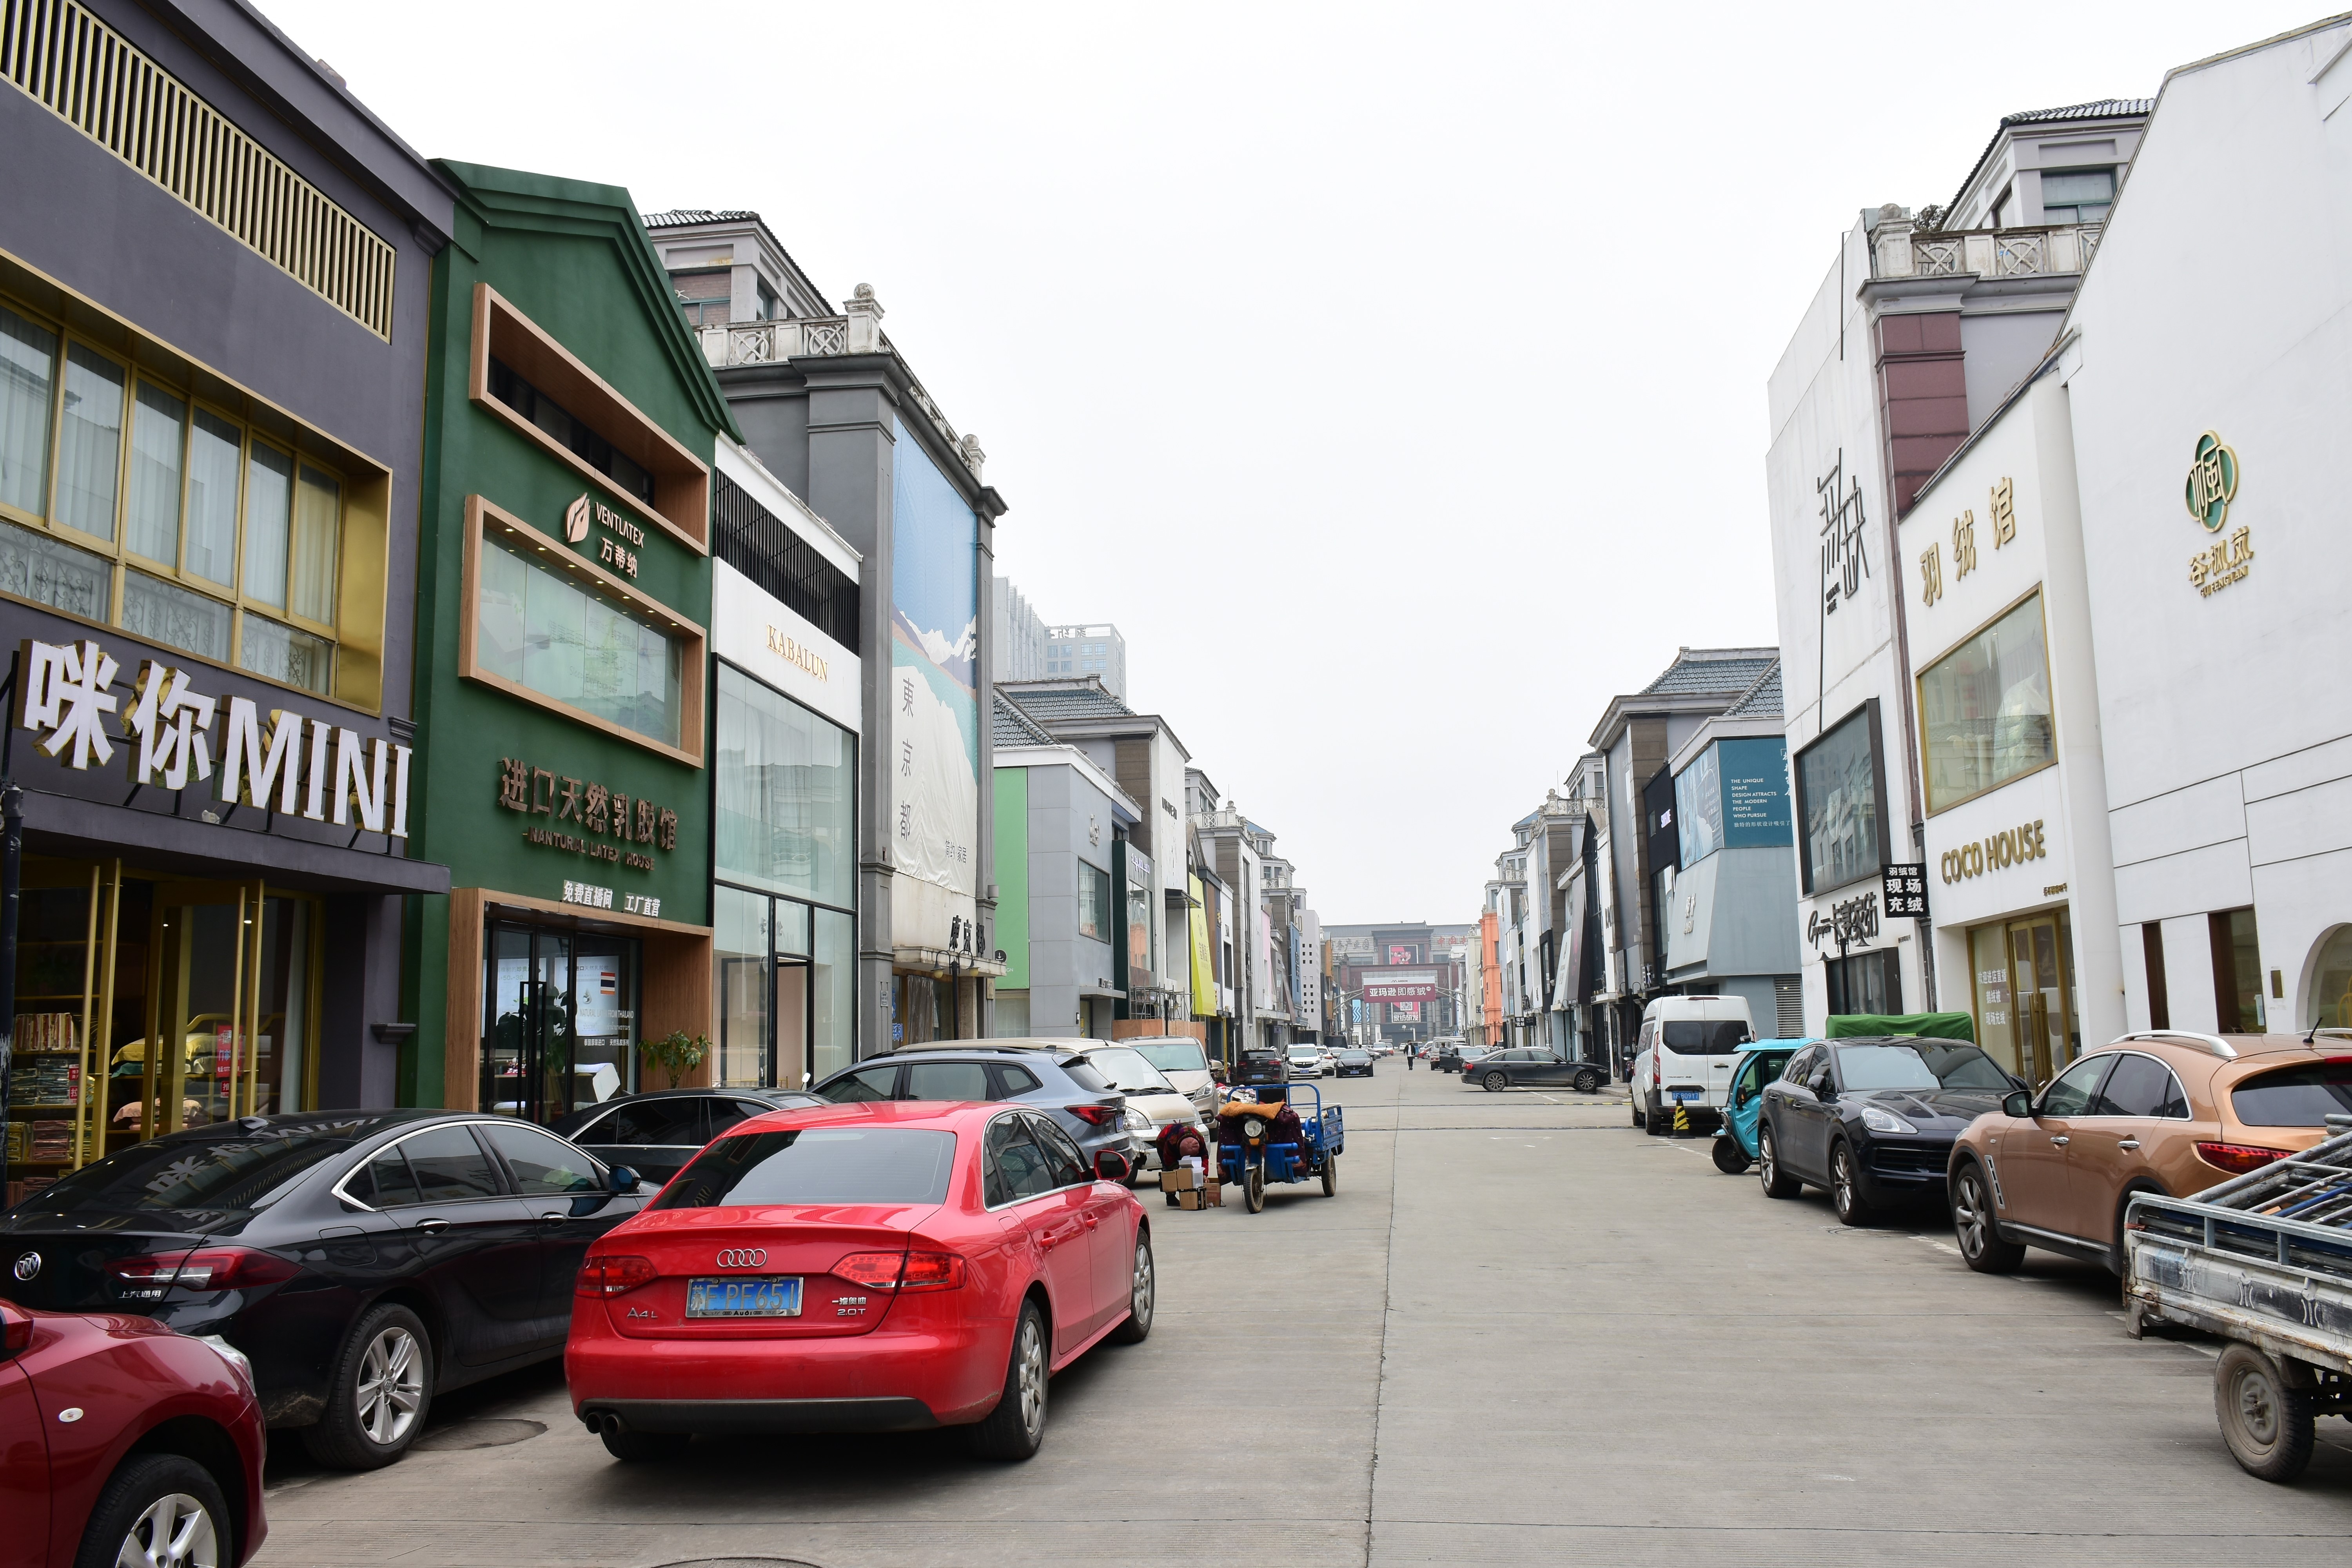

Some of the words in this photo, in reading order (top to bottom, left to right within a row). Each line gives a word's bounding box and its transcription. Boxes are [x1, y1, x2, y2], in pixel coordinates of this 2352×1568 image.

[595, 502, 644, 548] VENTLATEX
[1919, 476, 2016, 607] 羽绒馆
[601, 537, 637, 578] 万蒂纳
[2188, 525, 2254, 587] 谷枫岚
[2210, 576, 2229, 593] FENG
[767, 624, 828, 682] KABALUN
[900, 678, 914, 841] 東京都
[499, 757, 678, 850] 进口天然乳胶馆
[528, 827, 586, 853] NANTURAL
[589, 842, 621, 862] LATEX
[625, 851, 655, 871] HOUSE
[1941, 842, 1983, 884] COCO
[1985, 819, 2045, 872] HOUSE
[1886, 878, 1922, 893] 现场
[1888, 867, 1917, 876] 羽绒馆
[563, 881, 613, 909] 免费直播间
[625, 895, 660, 916] 工厂直营
[1888, 897, 1924, 912] 充绒
[618, 1010, 634, 1018] THAILAND
[118, 1290, 162, 1298] 上汽通用
[832, 1297, 866, 1305] 一汽奥迪
